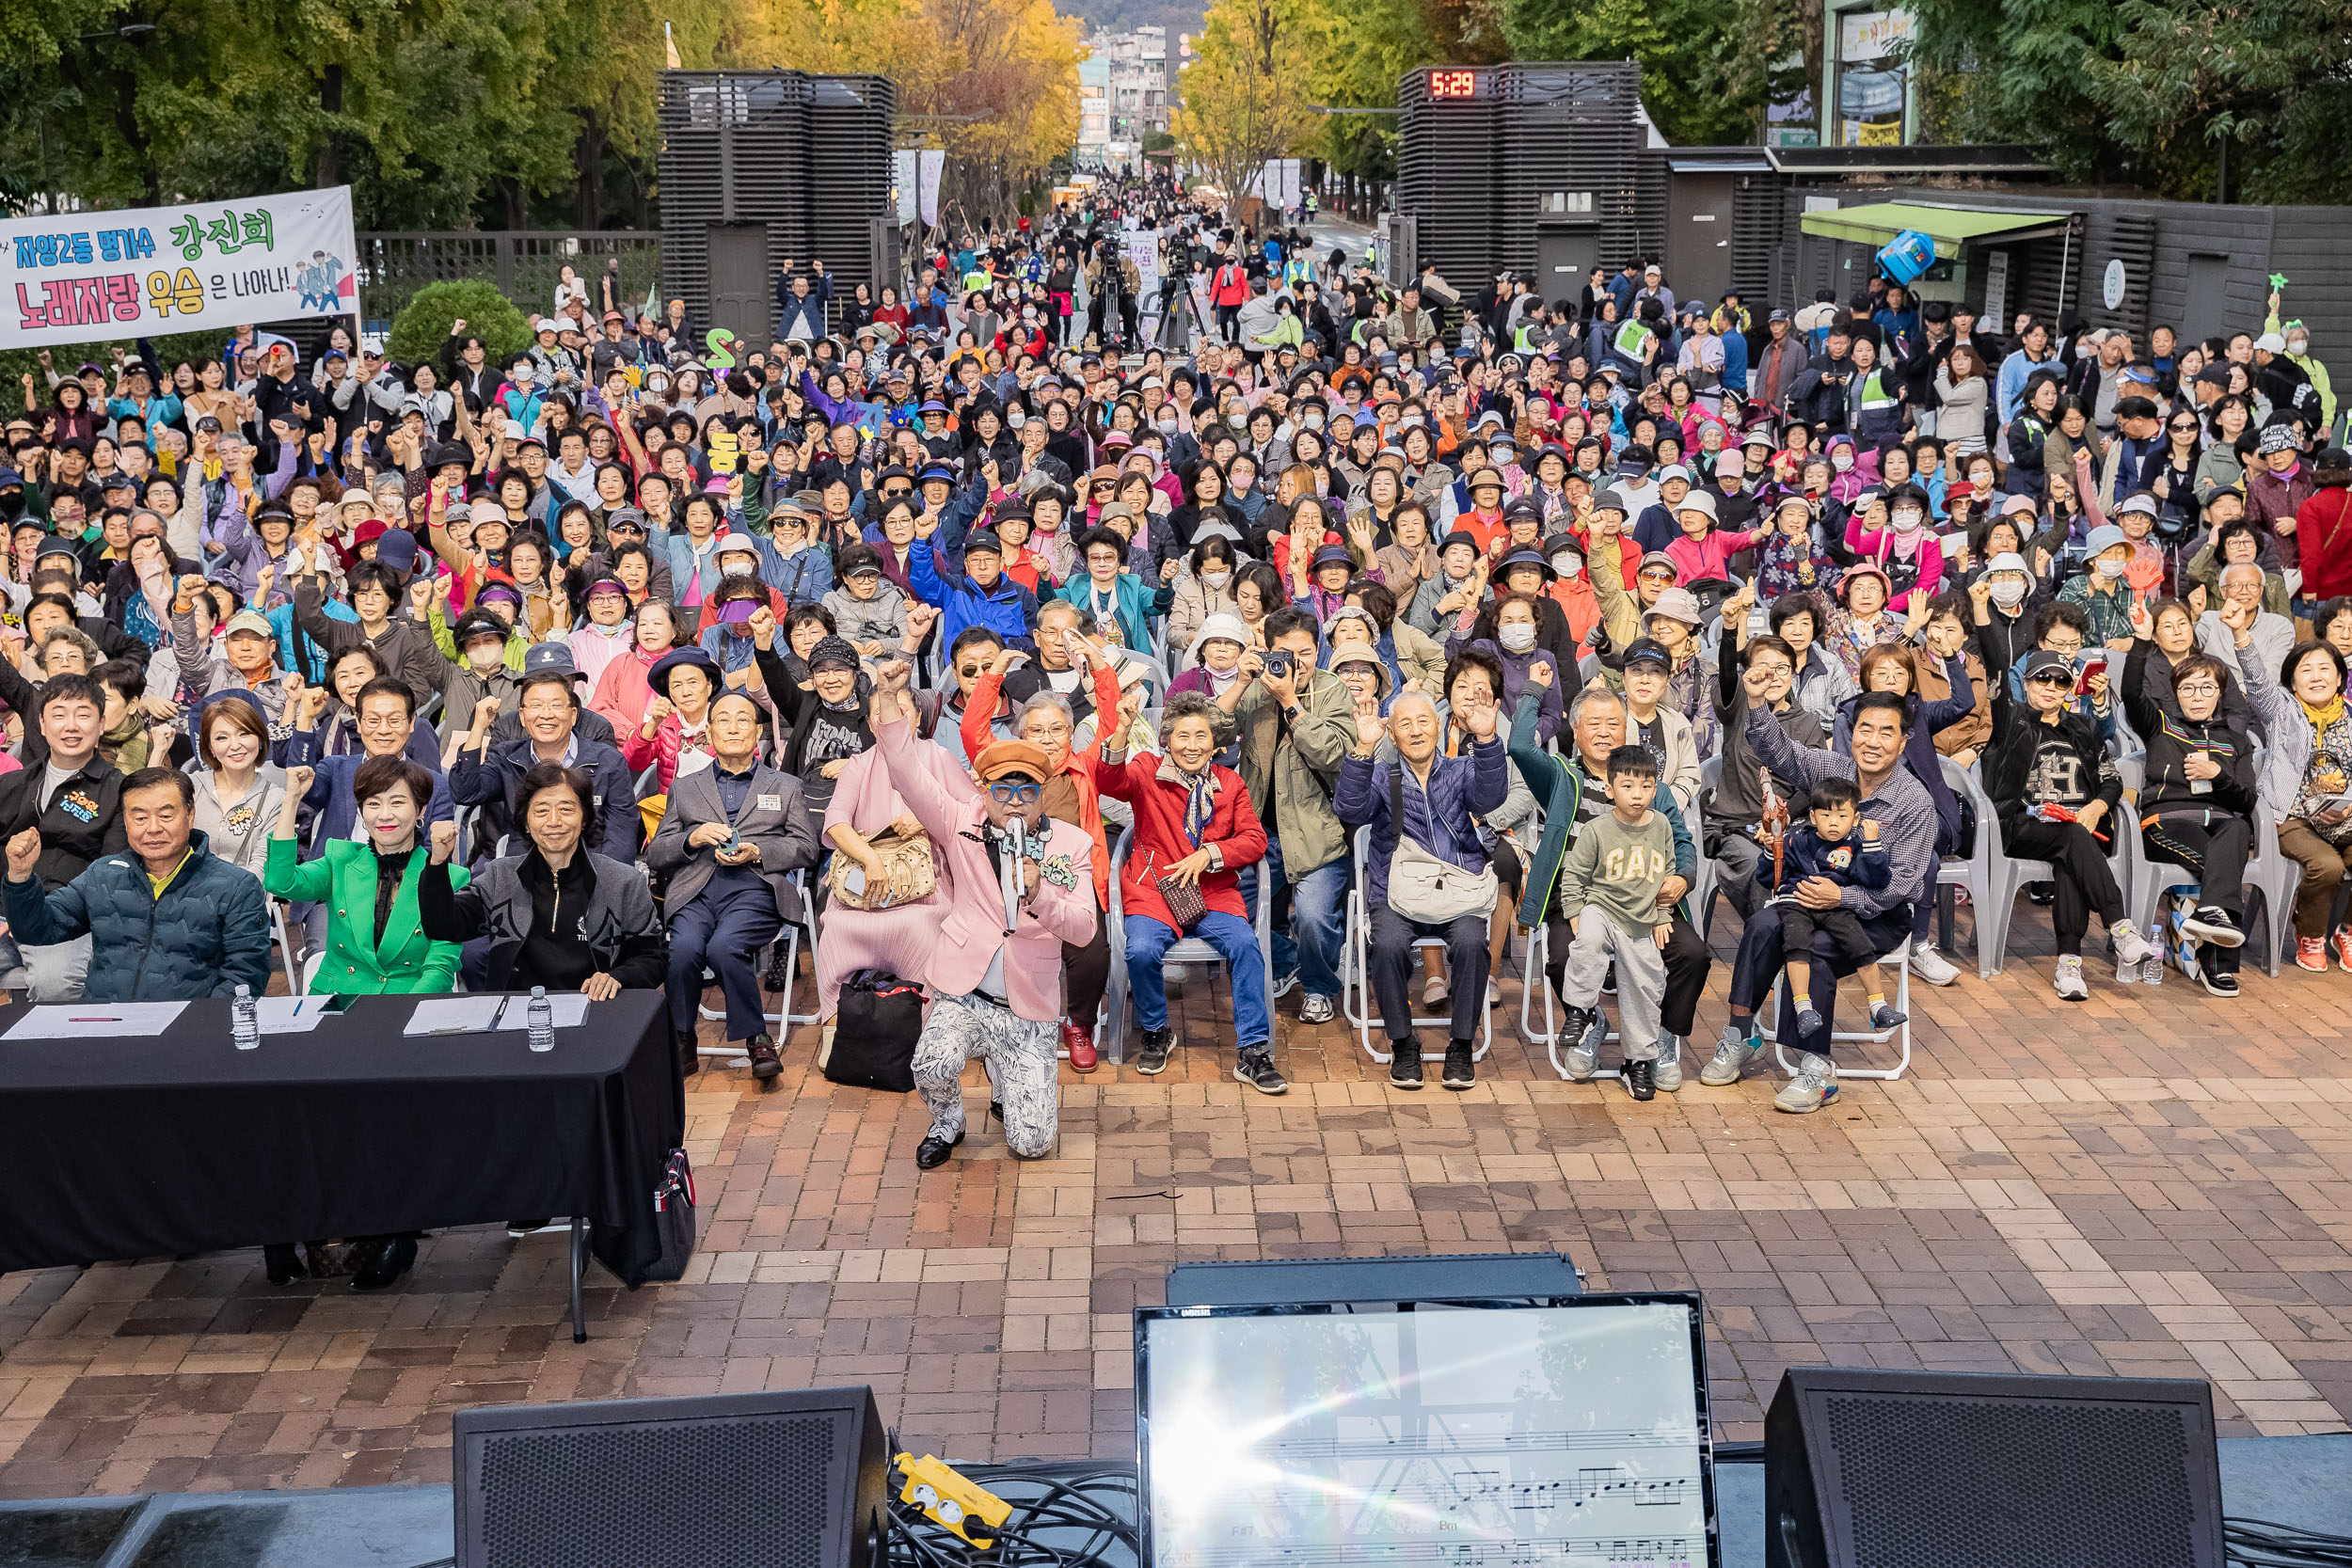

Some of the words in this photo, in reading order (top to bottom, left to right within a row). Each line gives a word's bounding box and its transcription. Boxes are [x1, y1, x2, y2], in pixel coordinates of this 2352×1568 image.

[1432, 71, 1474, 96] 5:29
[13, 231, 93, 269] 자양2동
[97, 227, 156, 261] 명가수
[169, 208, 274, 261] 강진희
[15, 273, 140, 330] 노래자랑
[147, 267, 204, 318] 우승
[211, 275, 227, 299] 은
[232, 266, 291, 297] 나야나!
[853, 400, 886, 438] 자
[707, 432, 739, 473] 동
[69, 790, 99, 813] 구의원
[228, 808, 254, 826] 구의원
[1046, 853, 1073, 873] MC
[1605, 844, 1664, 883] GAP
[1438, 1520, 1457, 1530] Bm
